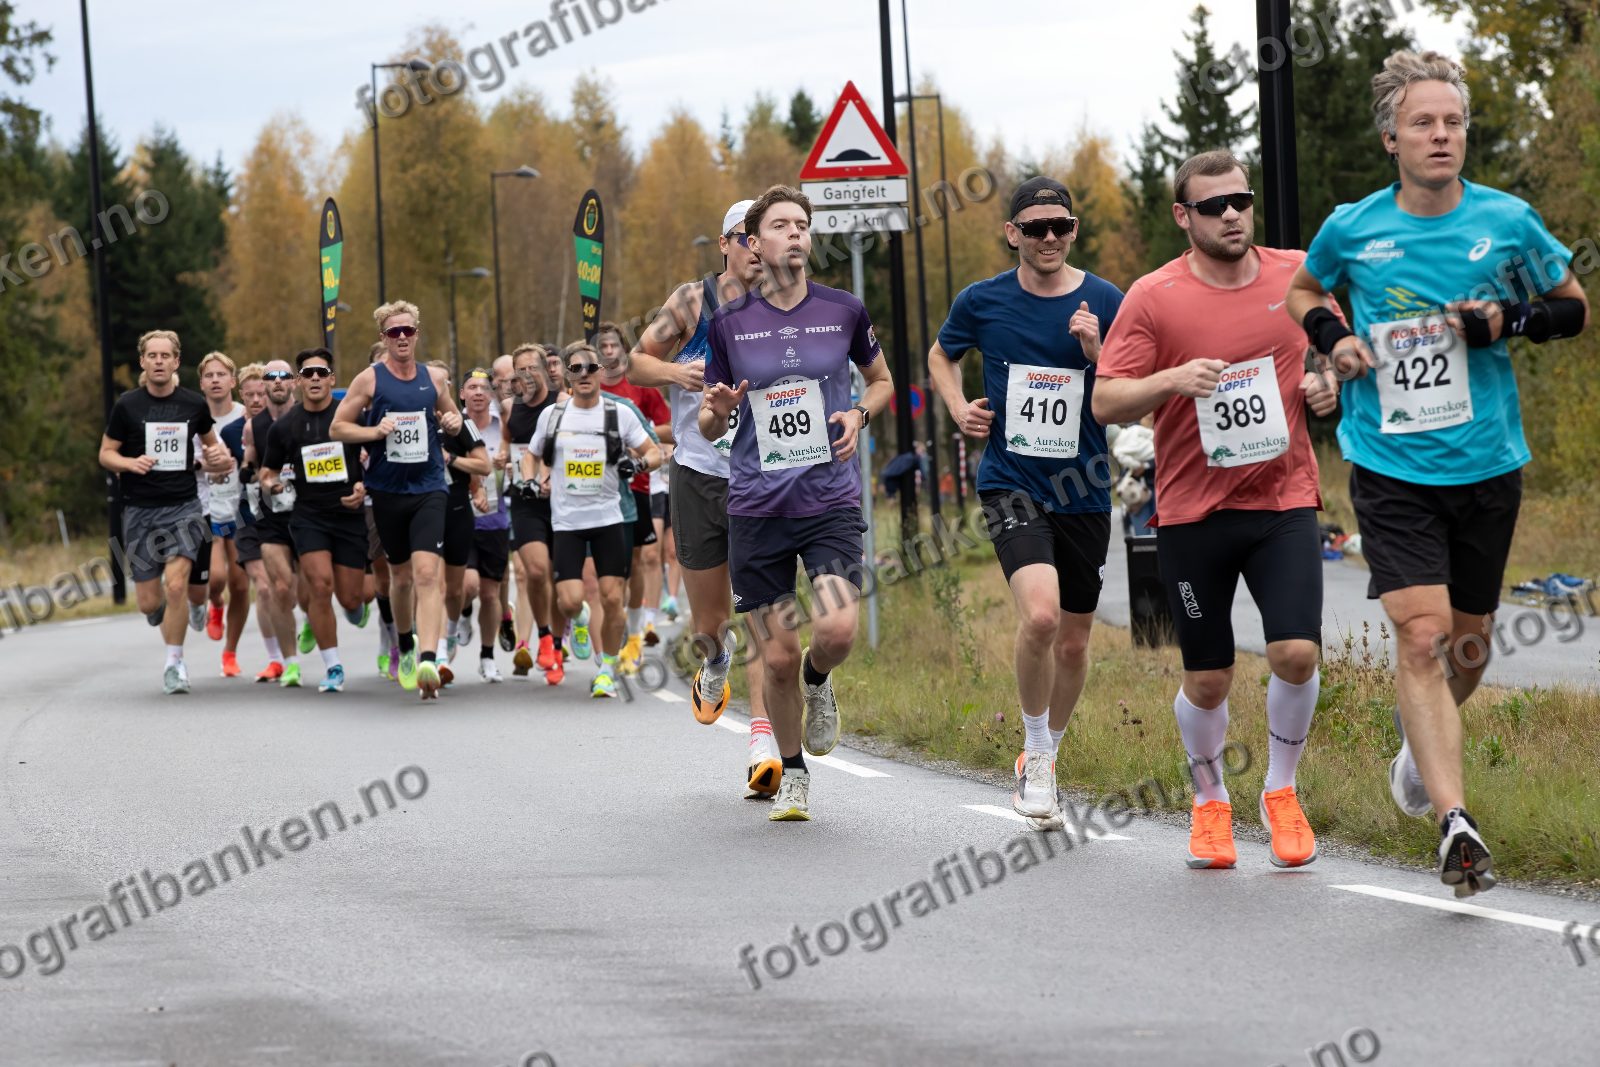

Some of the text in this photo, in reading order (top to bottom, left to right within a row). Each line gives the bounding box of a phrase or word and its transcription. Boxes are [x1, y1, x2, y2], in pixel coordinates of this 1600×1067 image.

[823, 186, 887, 202] Gangfelt
[828, 215, 838, 228] 0
[863, 214, 884, 227] km
[734, 325, 843, 341] ADAX ADAX
[1391, 323, 1447, 340] NORGES
[1026, 372, 1072, 384] NORGES
[1219, 367, 1260, 383] ORGES
[1394, 353, 1451, 391] 422
[1028, 381, 1063, 392] LØPET
[1217, 378, 1254, 393] LØPET
[764, 387, 807, 401] NORGES
[770, 396, 802, 409] LØPET
[1418, 400, 1469, 417] Aurskog
[1020, 396, 1067, 426] 410
[1214, 394, 1266, 431] 389
[769, 409, 811, 439] 489
[394, 429, 420, 445] 384
[1034, 436, 1076, 449] Aurskog
[1240, 436, 1287, 452] Aurskog
[154, 438, 179, 453] 818
[788, 444, 828, 458] Aurskog
[309, 458, 342, 475] PACE
[567, 463, 601, 476] PACE
[1178, 581, 1203, 619] 2XU
